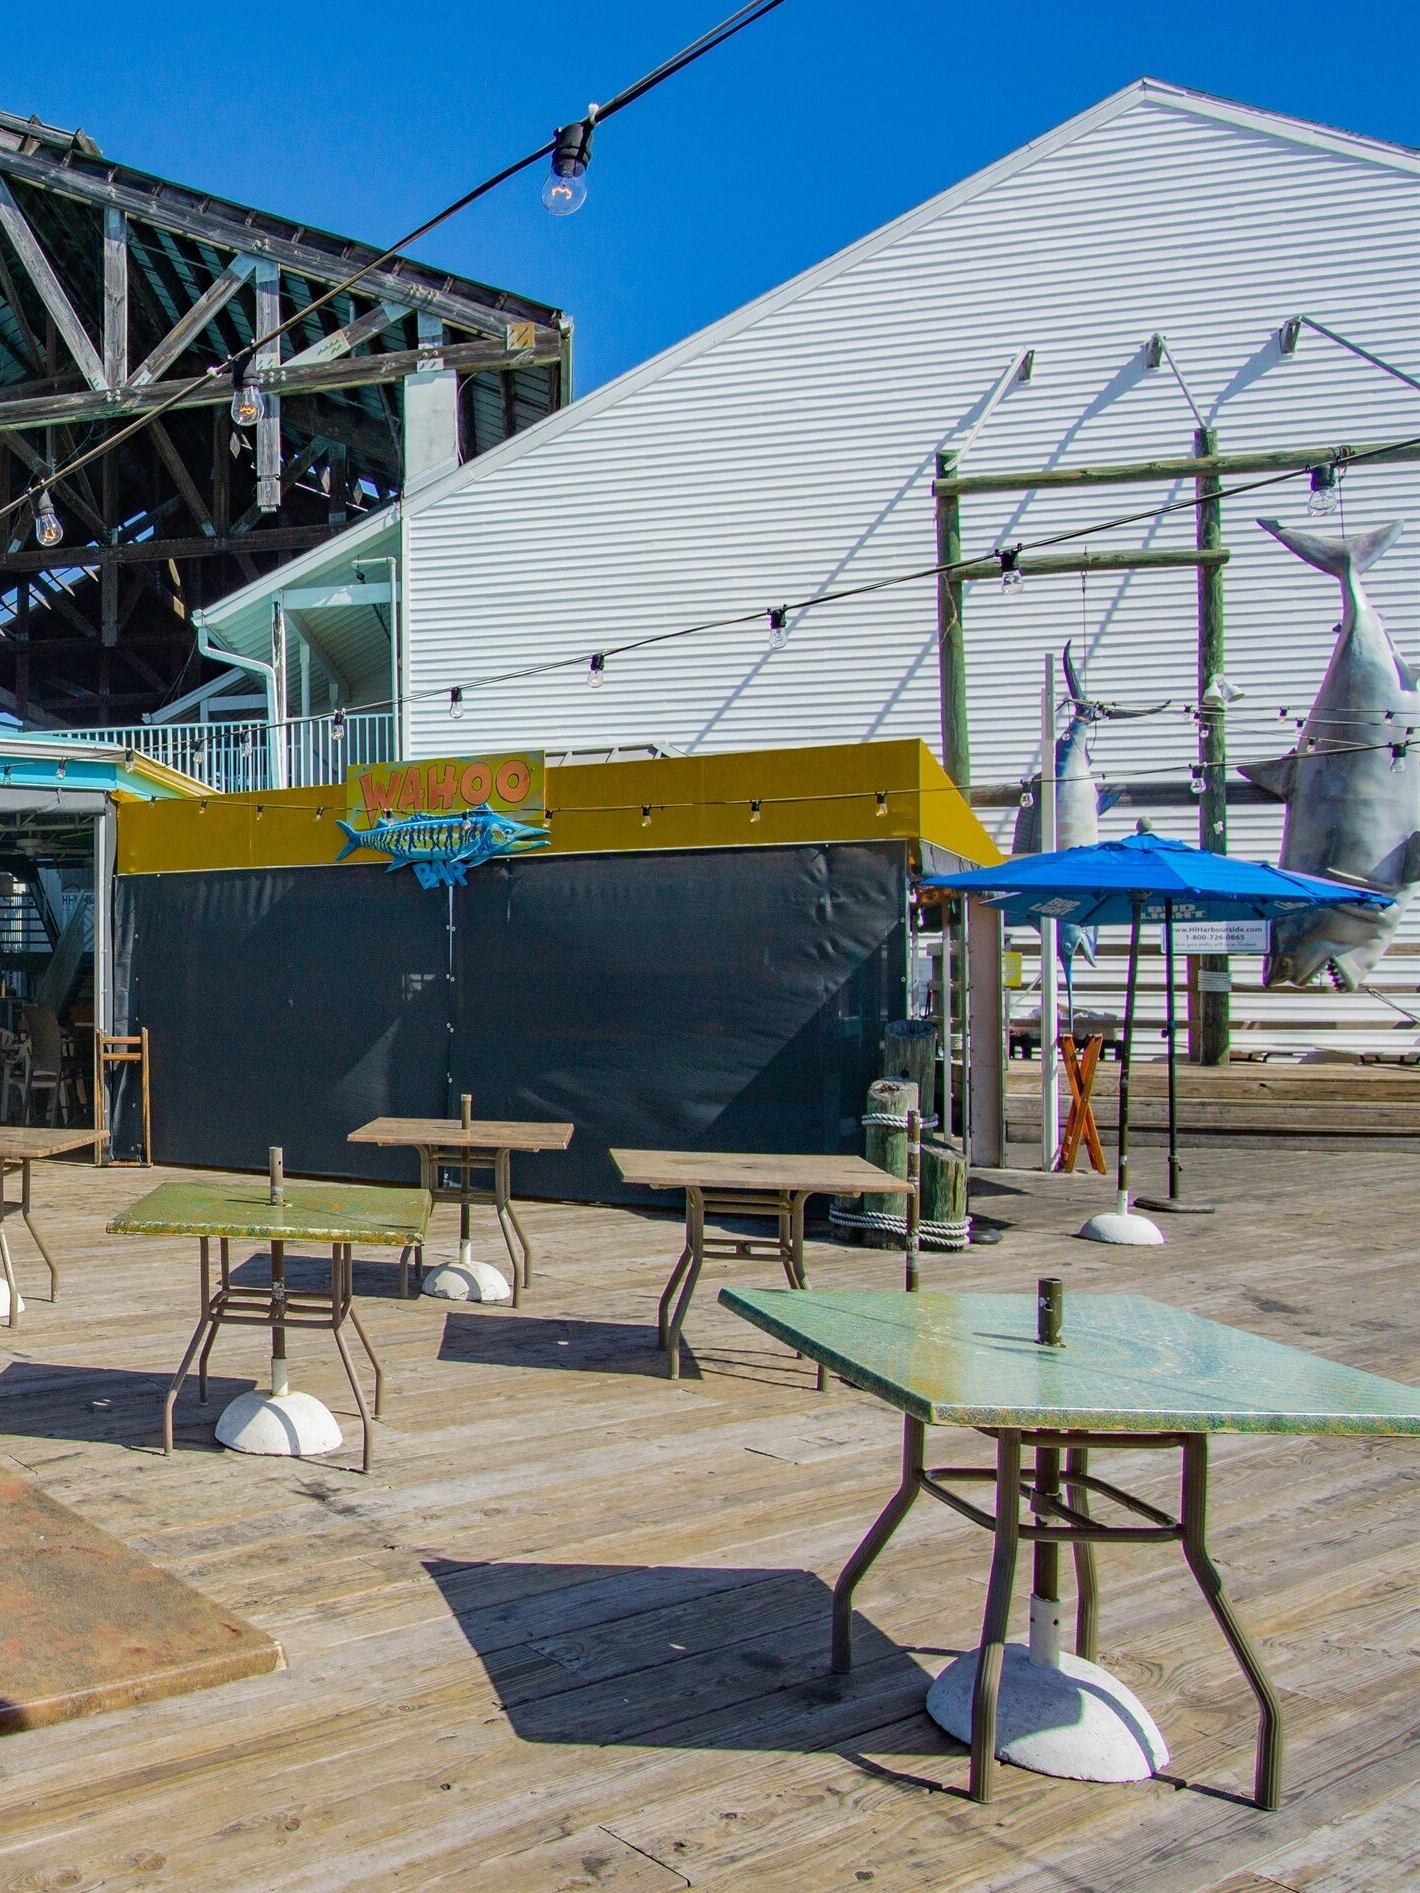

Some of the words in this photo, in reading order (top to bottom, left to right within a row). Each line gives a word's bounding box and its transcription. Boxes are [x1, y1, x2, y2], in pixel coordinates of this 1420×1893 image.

[359, 759, 530, 829] WAHOO
[411, 860, 469, 891] BAR
[1028, 902, 1076, 916] LIGHT
[1147, 903, 1197, 914] BUD
